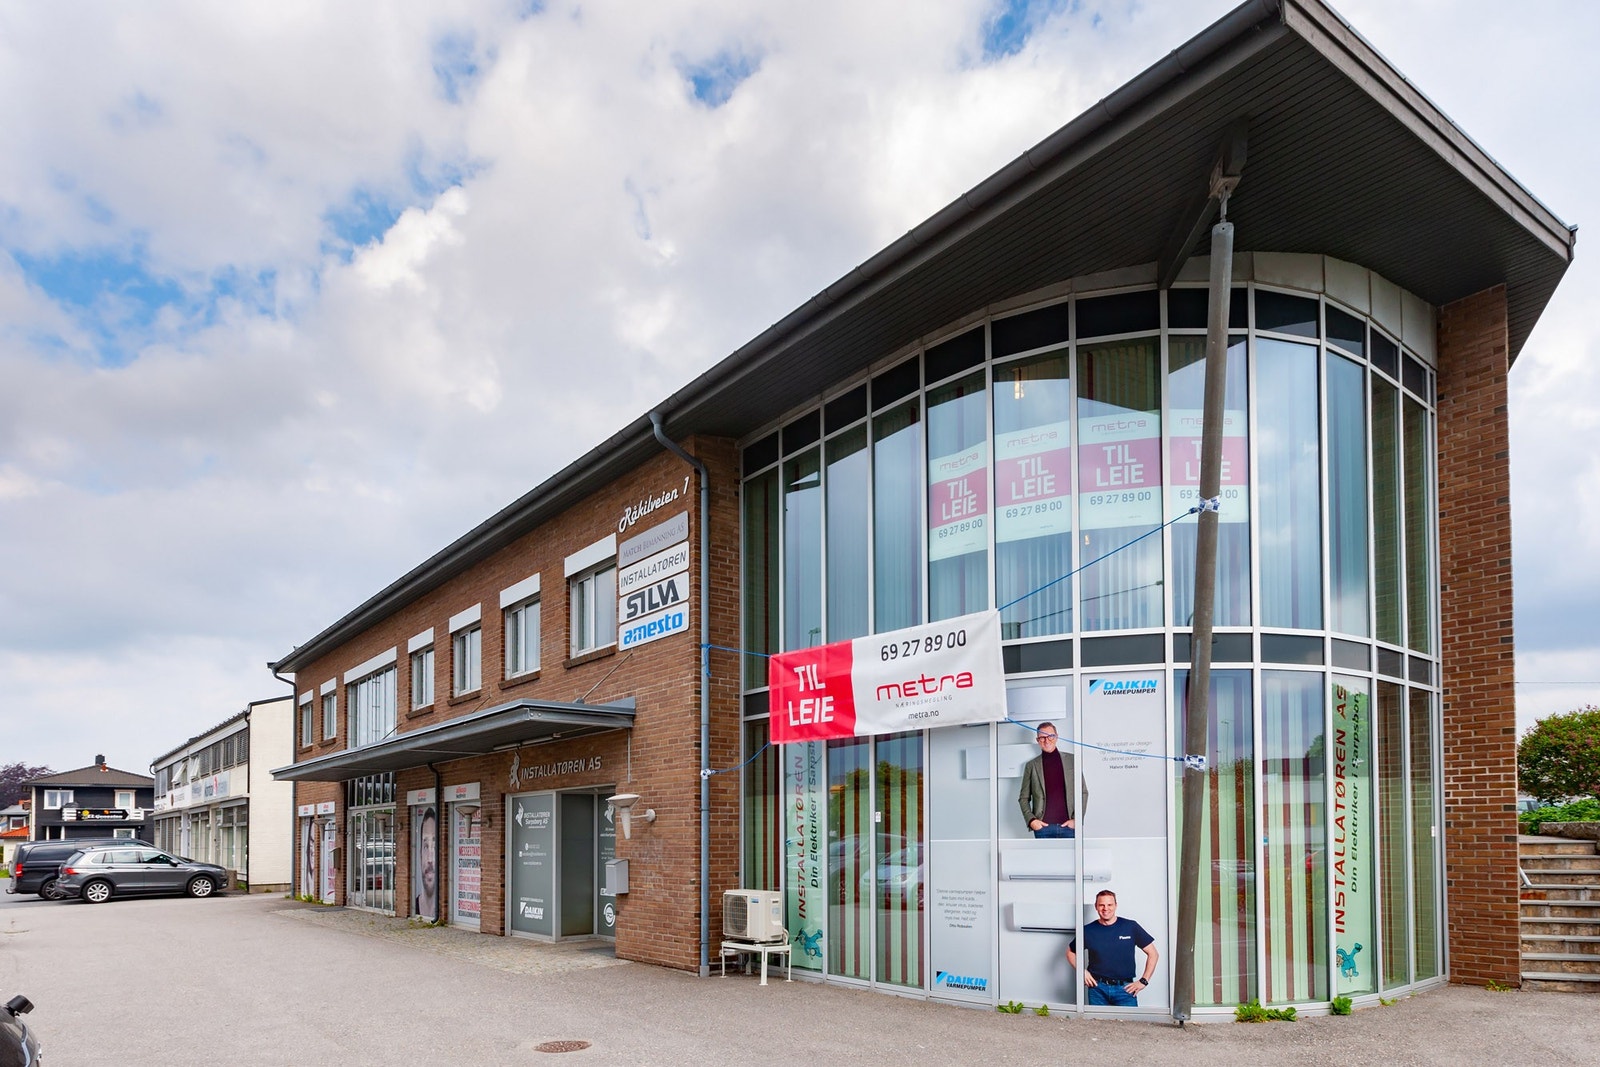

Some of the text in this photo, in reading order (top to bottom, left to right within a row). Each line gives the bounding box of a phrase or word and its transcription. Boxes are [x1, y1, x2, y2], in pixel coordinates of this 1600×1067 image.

[1092, 419, 1147, 432] metra
[1007, 431, 1057, 448] metra
[940, 452, 979, 471] metra
[1102, 444, 1137, 465] TIL
[1017, 456, 1049, 478] TIL
[1096, 464, 1144, 487] LEIE
[1185, 461, 1232, 481] LE
[947, 478, 972, 499] TIL
[1011, 474, 1056, 500] LEIE
[1090, 491, 1151, 505] 69 27 89 00
[618, 487, 678, 533] Råkilveien
[942, 493, 977, 520] LEIE
[1006, 500, 1062, 518] 69 27 89 00
[938, 518, 983, 539] 69 27 89 00
[623, 544, 642, 560] MATCH
[620, 551, 687, 587] INSTALLATØREN
[626, 579, 680, 619] SILVA
[623, 612, 683, 645] amesto
[881, 629, 967, 662] 69 27 89 00
[794, 664, 826, 692] TIL
[876, 671, 974, 701] metra
[1103, 680, 1158, 690] DAIKIN
[788, 695, 834, 727] LEIE
[908, 710, 940, 719] metra.no
[521, 756, 602, 780] INSTALLATØREN AS
[795, 756, 806, 919] INSTALLATØREN
[809, 797, 818, 862] Elektriker
[1334, 729, 1347, 933] INSTALLATØREN
[946, 974, 988, 987] DAIKIN
[946, 983, 986, 991] VARMEPUMPER
